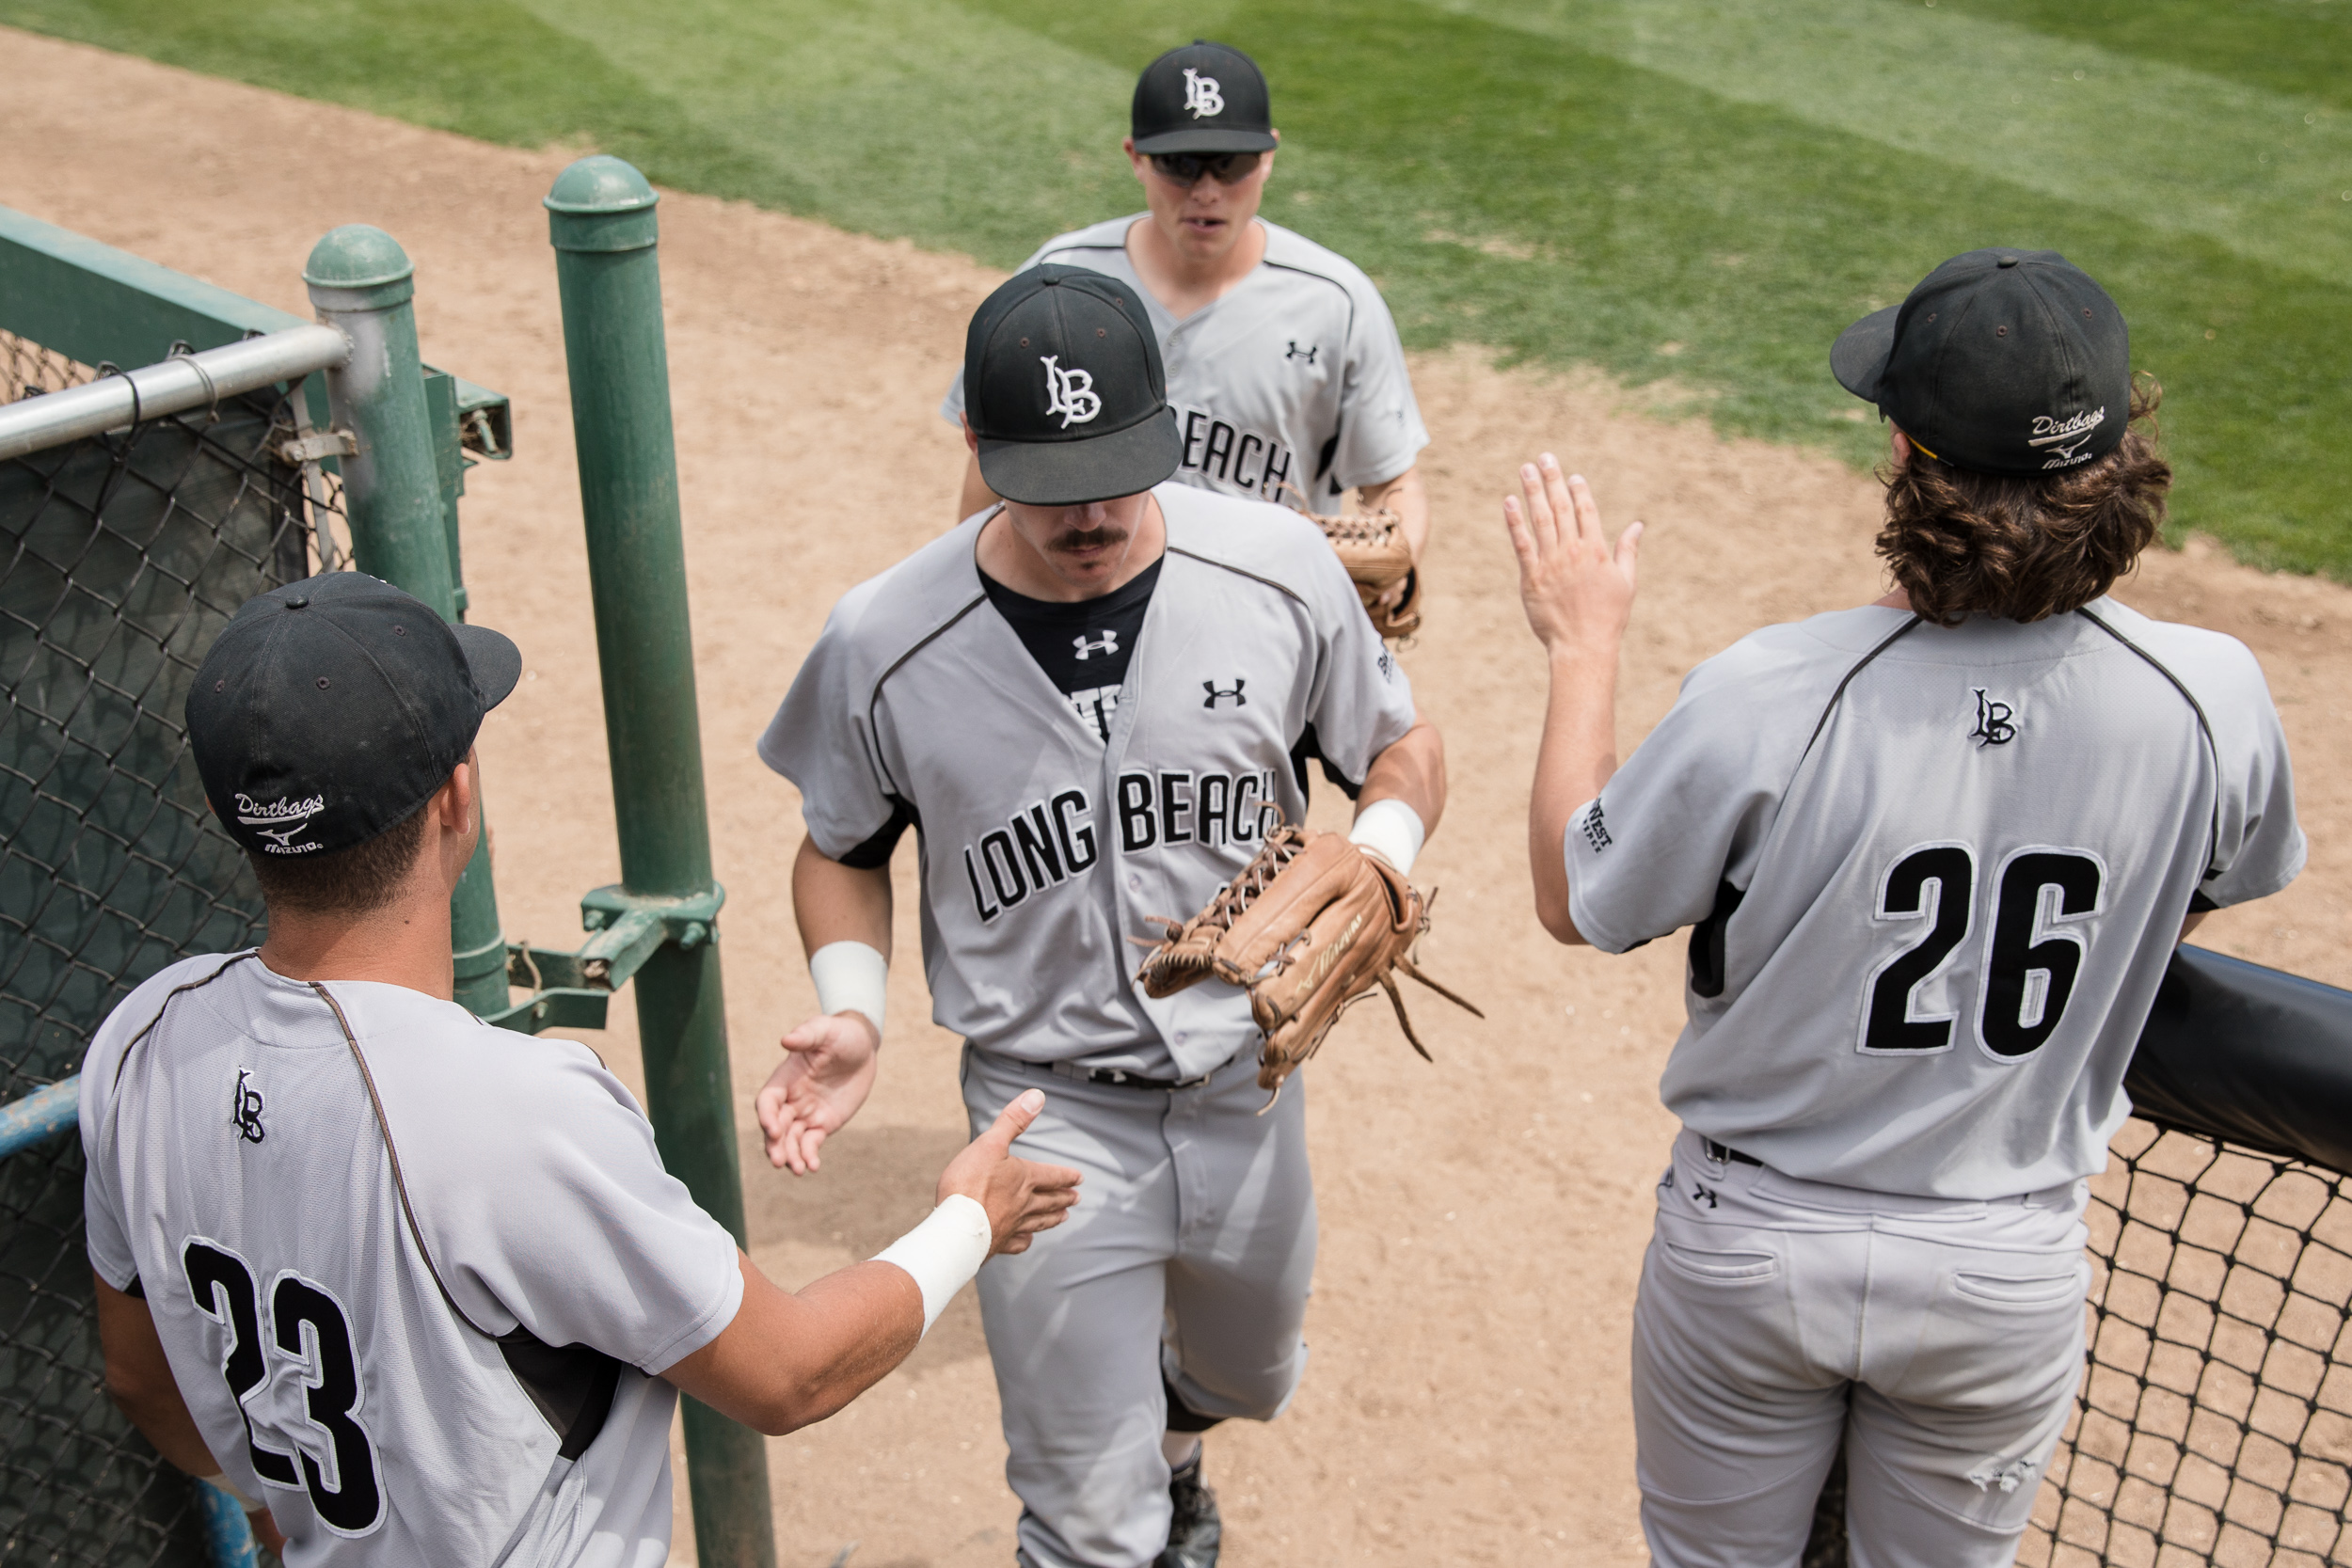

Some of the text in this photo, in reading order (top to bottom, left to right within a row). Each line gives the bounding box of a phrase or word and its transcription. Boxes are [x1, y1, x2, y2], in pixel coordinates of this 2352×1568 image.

[1182, 67, 1225, 120] LB
[1040, 355, 1102, 429] LB
[2032, 405, 2106, 434] Dirtbags
[1167, 401, 1295, 504] EACH
[1969, 688, 2017, 749] LB
[235, 794, 325, 818] Dirtbags
[964, 768, 1277, 924] LONG BEACH
[1855, 840, 2107, 1065] 26
[180, 1234, 388, 1539] 23
